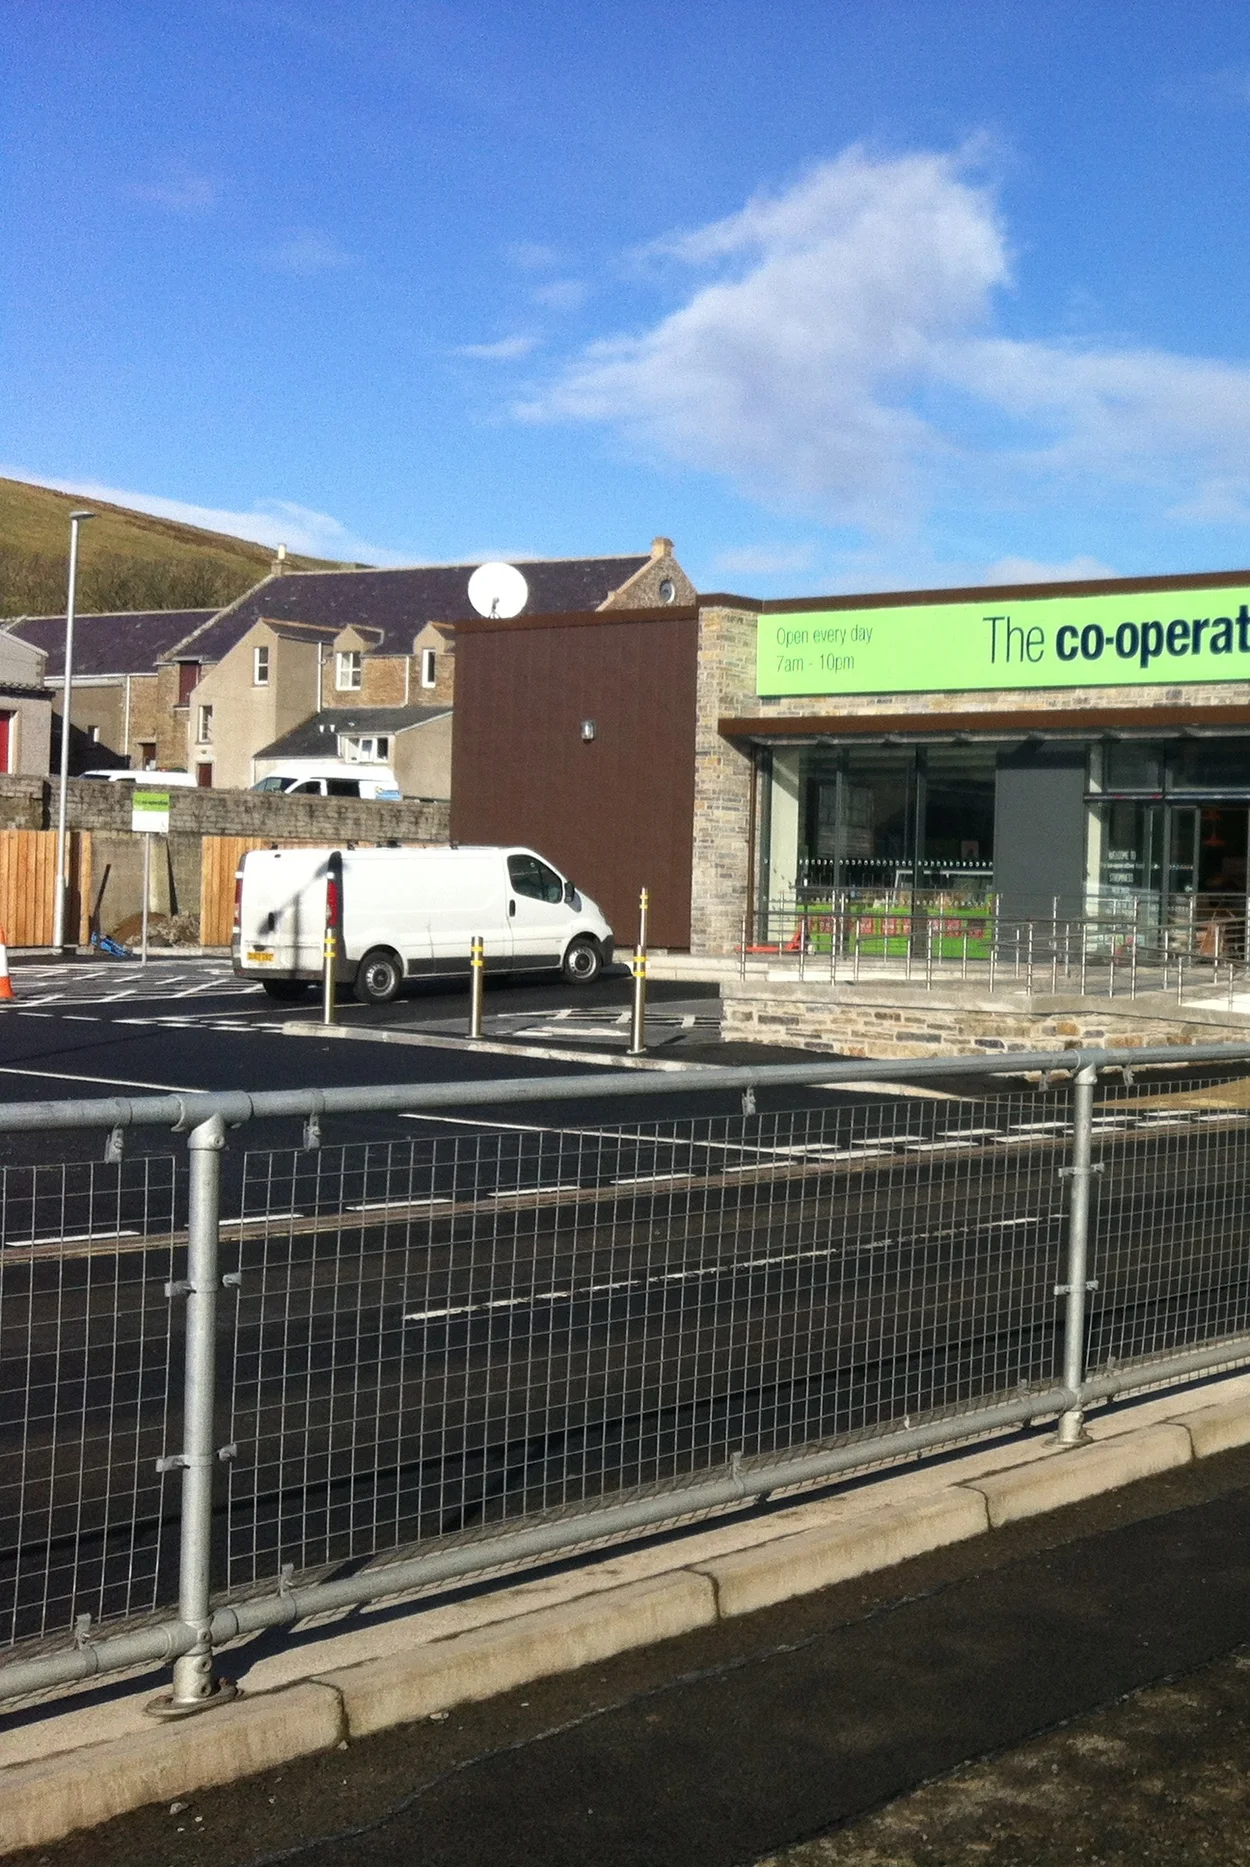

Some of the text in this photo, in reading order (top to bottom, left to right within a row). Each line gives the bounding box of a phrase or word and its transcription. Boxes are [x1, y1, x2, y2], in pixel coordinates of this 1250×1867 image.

[776, 624, 873, 648] Open every day
[983, 616, 1045, 664] The
[776, 655, 804, 673] 7am
[820, 652, 855, 674] 10pm
